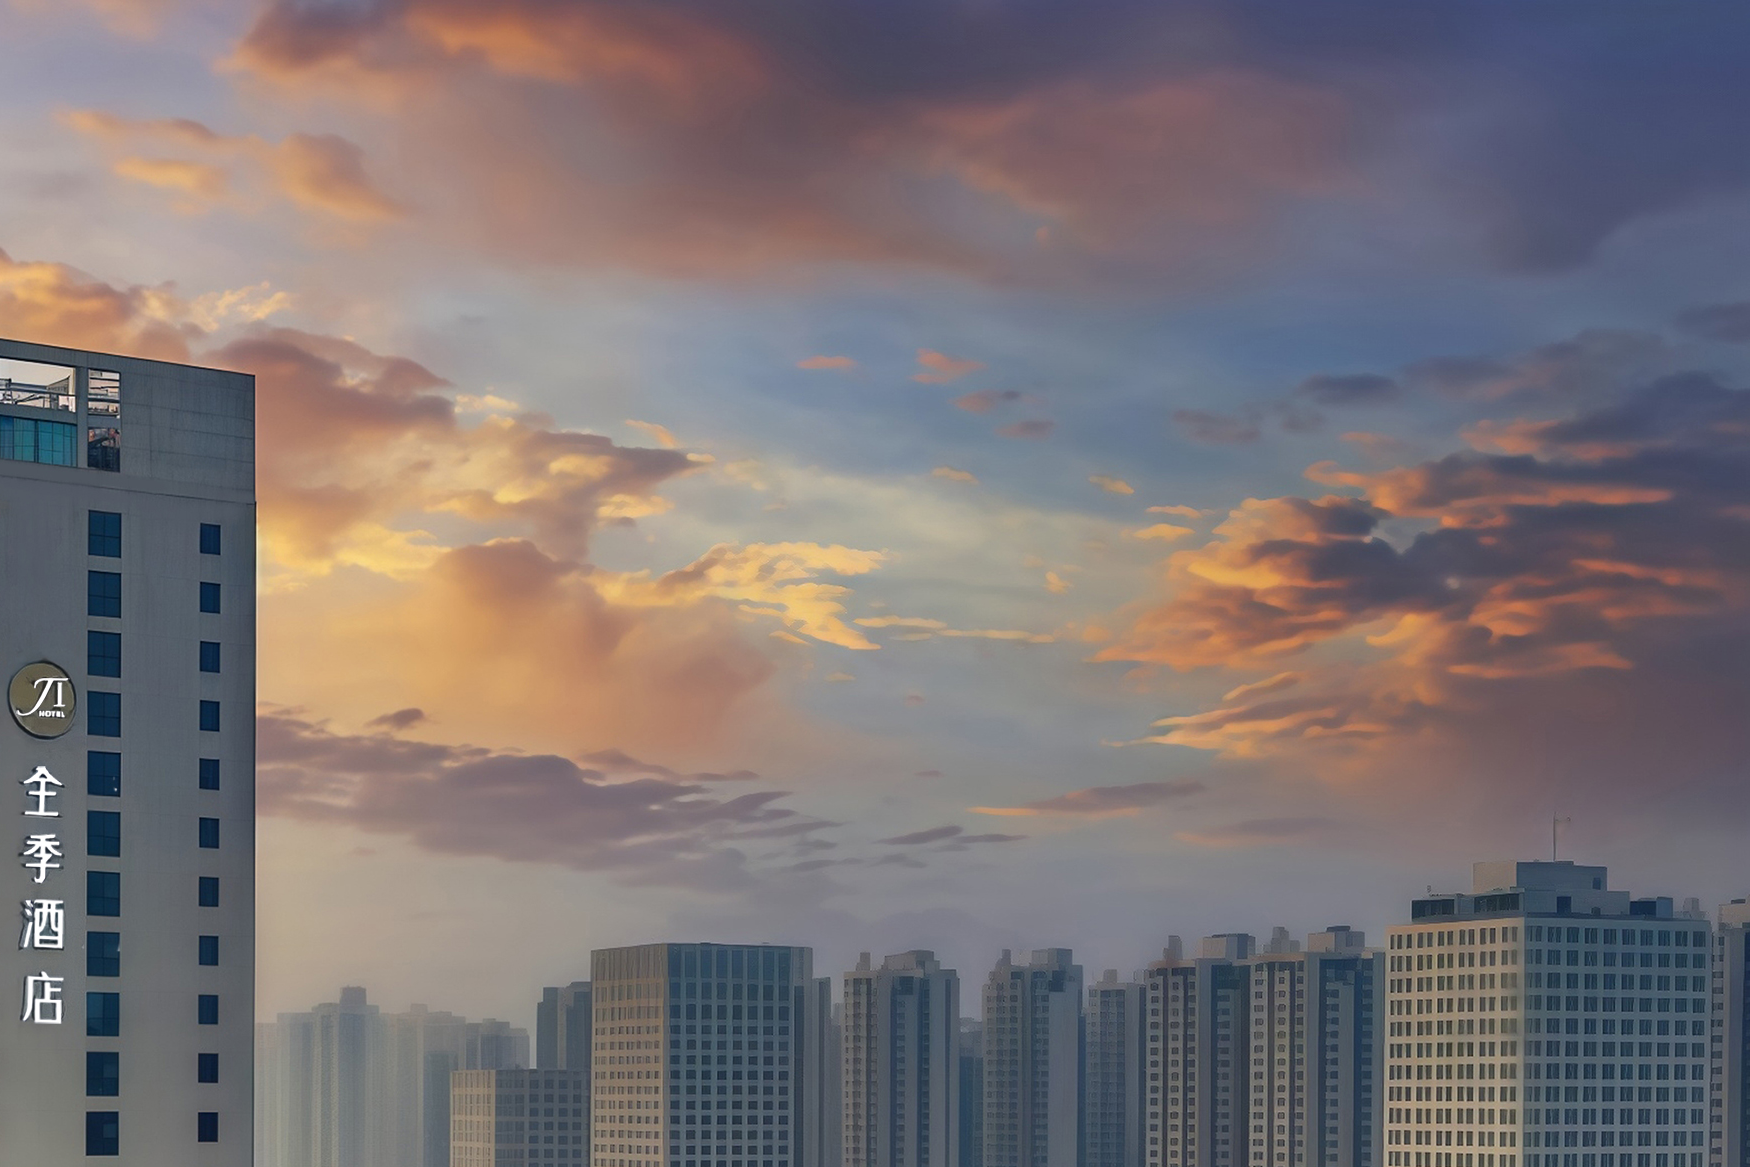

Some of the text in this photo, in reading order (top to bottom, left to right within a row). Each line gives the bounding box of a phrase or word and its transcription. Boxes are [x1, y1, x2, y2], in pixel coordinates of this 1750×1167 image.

[38, 710, 66, 718] HOTEL
[23, 766, 65, 1025] 全季酒店
